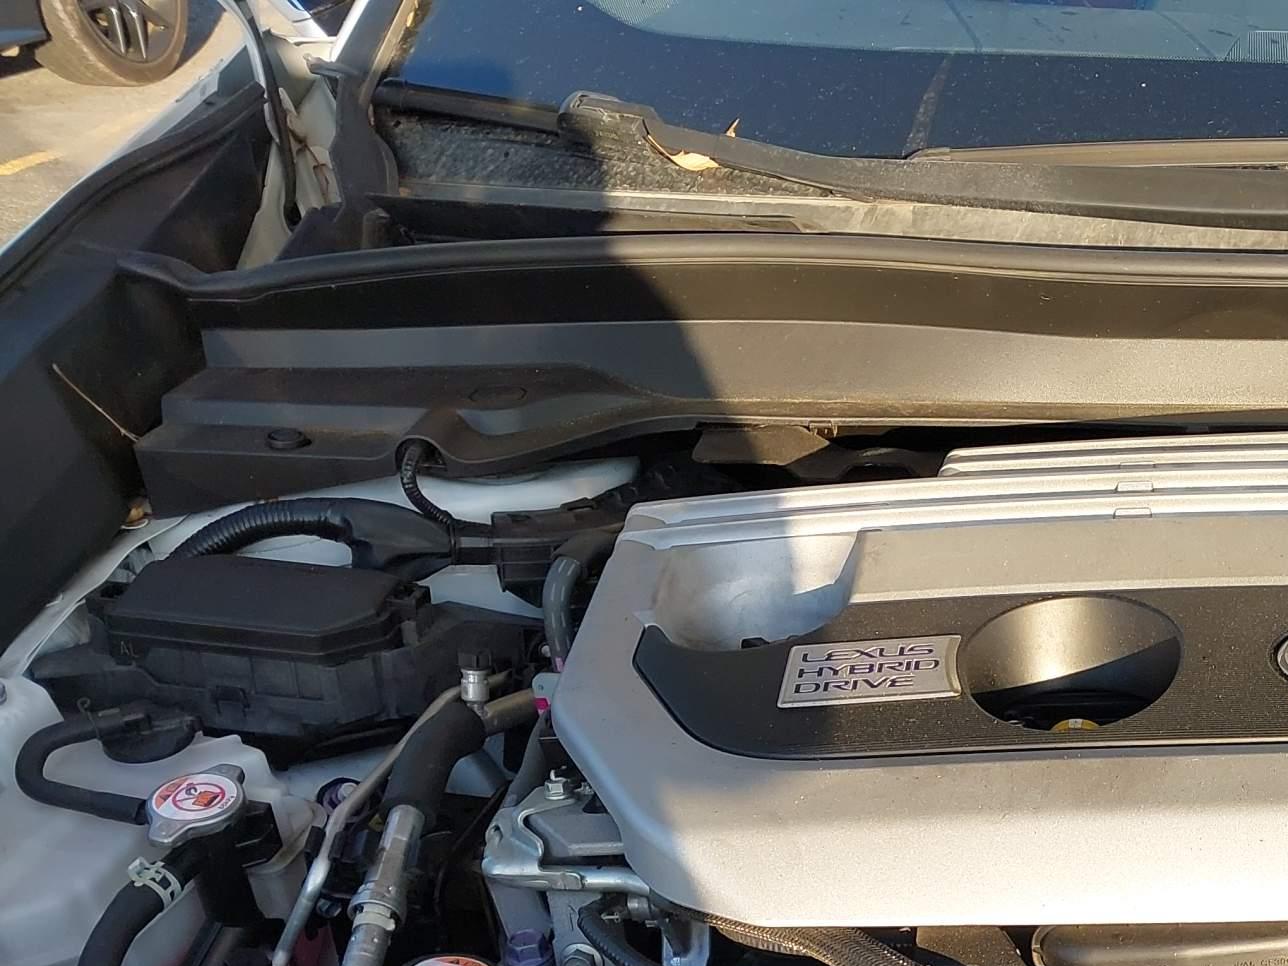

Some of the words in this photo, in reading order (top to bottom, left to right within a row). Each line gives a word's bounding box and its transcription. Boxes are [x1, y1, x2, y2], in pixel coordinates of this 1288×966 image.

[801, 644, 935, 663] LEXUS
[797, 659, 940, 679] HYBRID
[793, 674, 916, 694] DRIVE
